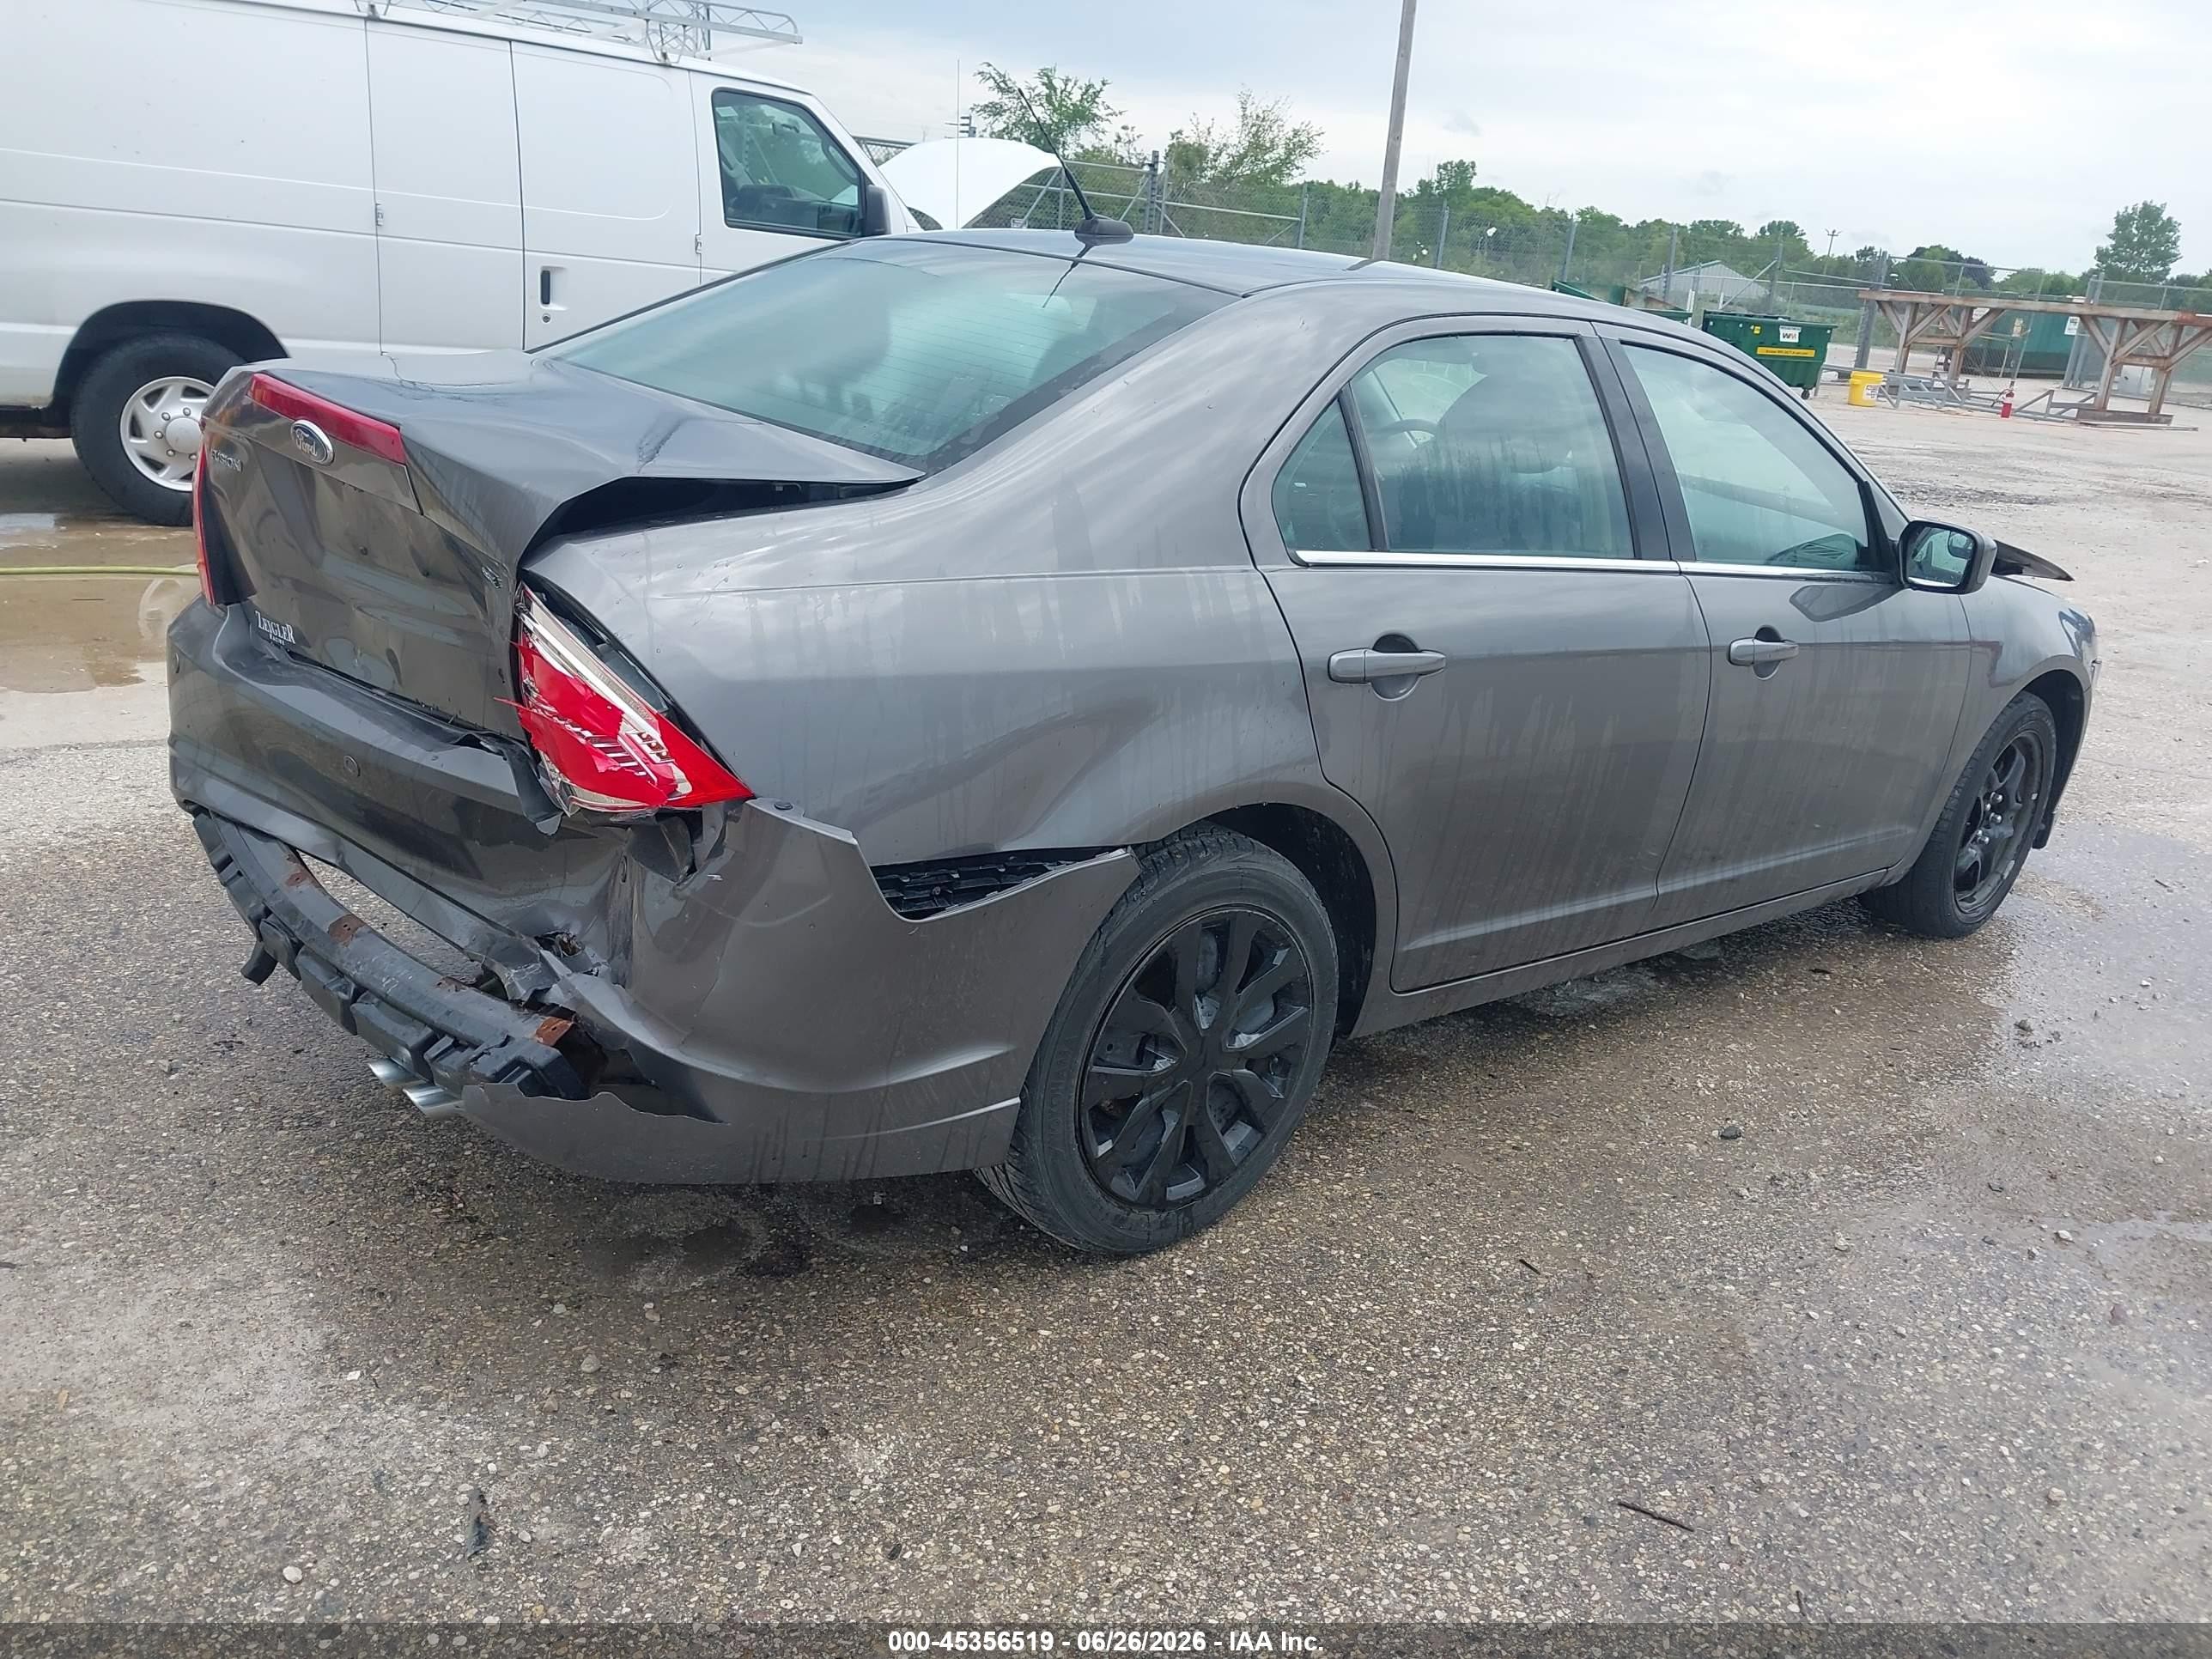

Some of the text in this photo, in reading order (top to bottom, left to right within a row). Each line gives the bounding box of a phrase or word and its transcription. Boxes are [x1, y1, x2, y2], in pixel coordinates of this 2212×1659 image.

[295, 428, 318, 457] Ford
[211, 447, 244, 473] FUSION
[254, 610, 296, 645] ZEIGLER
